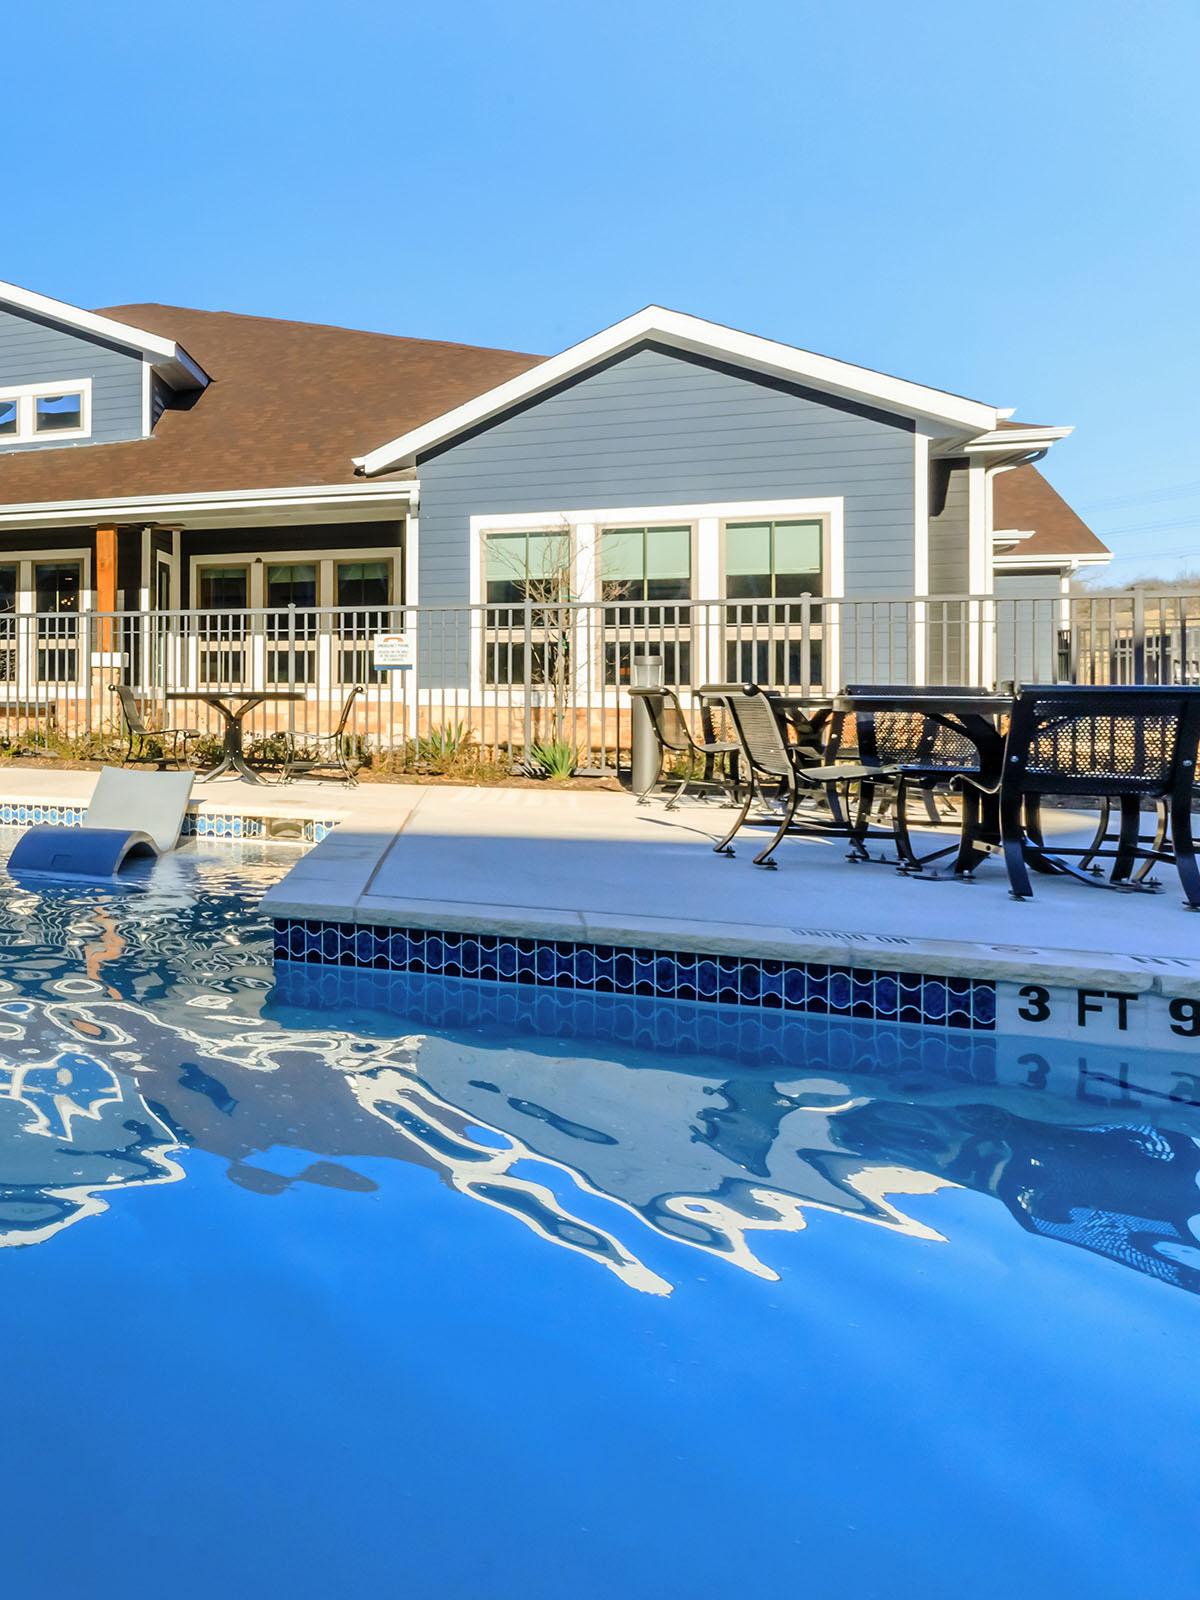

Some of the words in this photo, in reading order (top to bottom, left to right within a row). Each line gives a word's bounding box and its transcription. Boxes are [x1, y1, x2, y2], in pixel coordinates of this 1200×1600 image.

[1018, 985, 1051, 1022] 3
[1077, 989, 1139, 1031] FT
[1169, 998, 1200, 1037] 9
